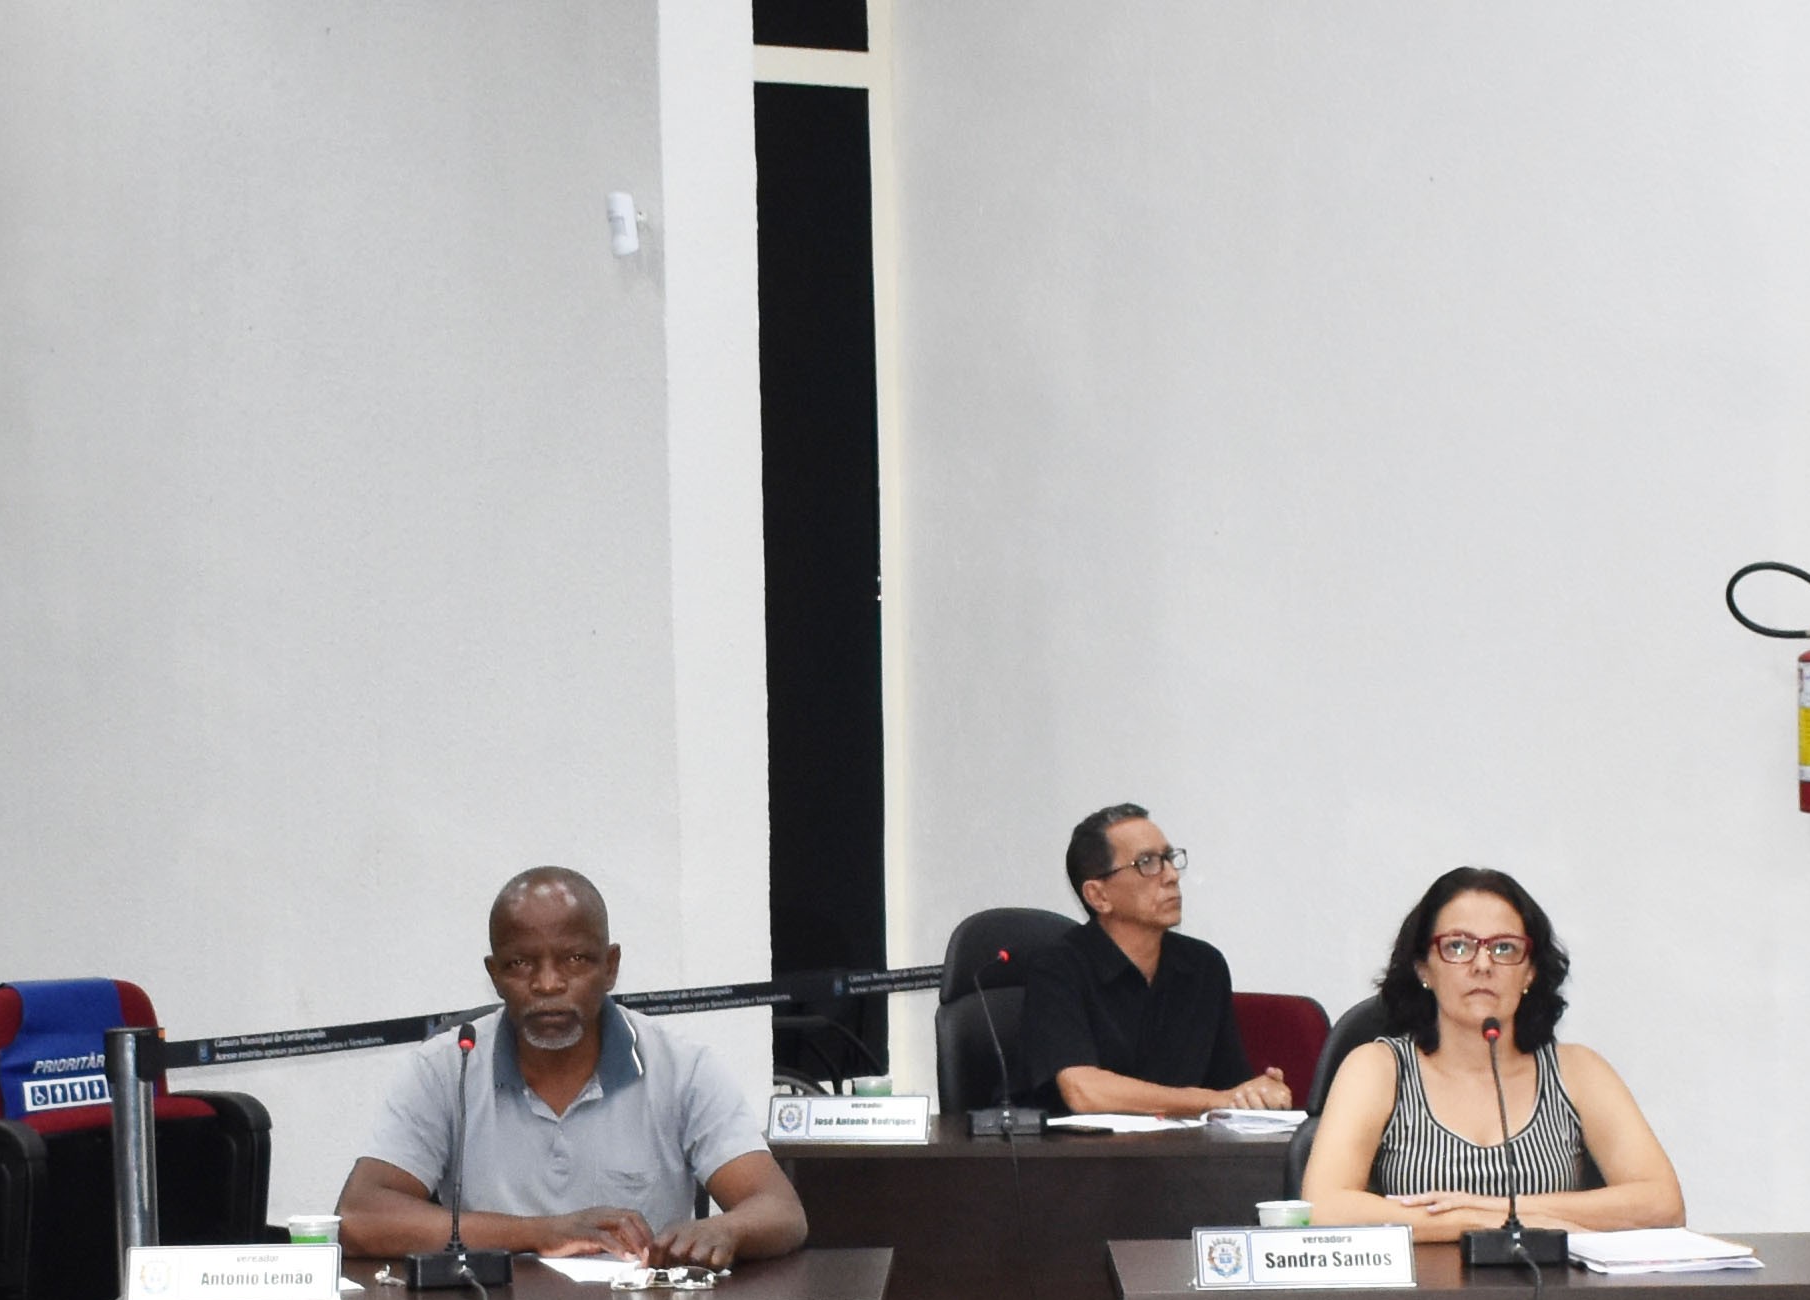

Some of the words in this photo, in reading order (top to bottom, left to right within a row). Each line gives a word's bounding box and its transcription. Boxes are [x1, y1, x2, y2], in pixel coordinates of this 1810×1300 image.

[33, 1052, 106, 1074] PRIORITÁR
[1302, 1234, 1352, 1244] vereadora
[1265, 1252, 1327, 1269] Sandra
[1332, 1251, 1392, 1267] Santos
[201, 1271, 259, 1286] Antonio
